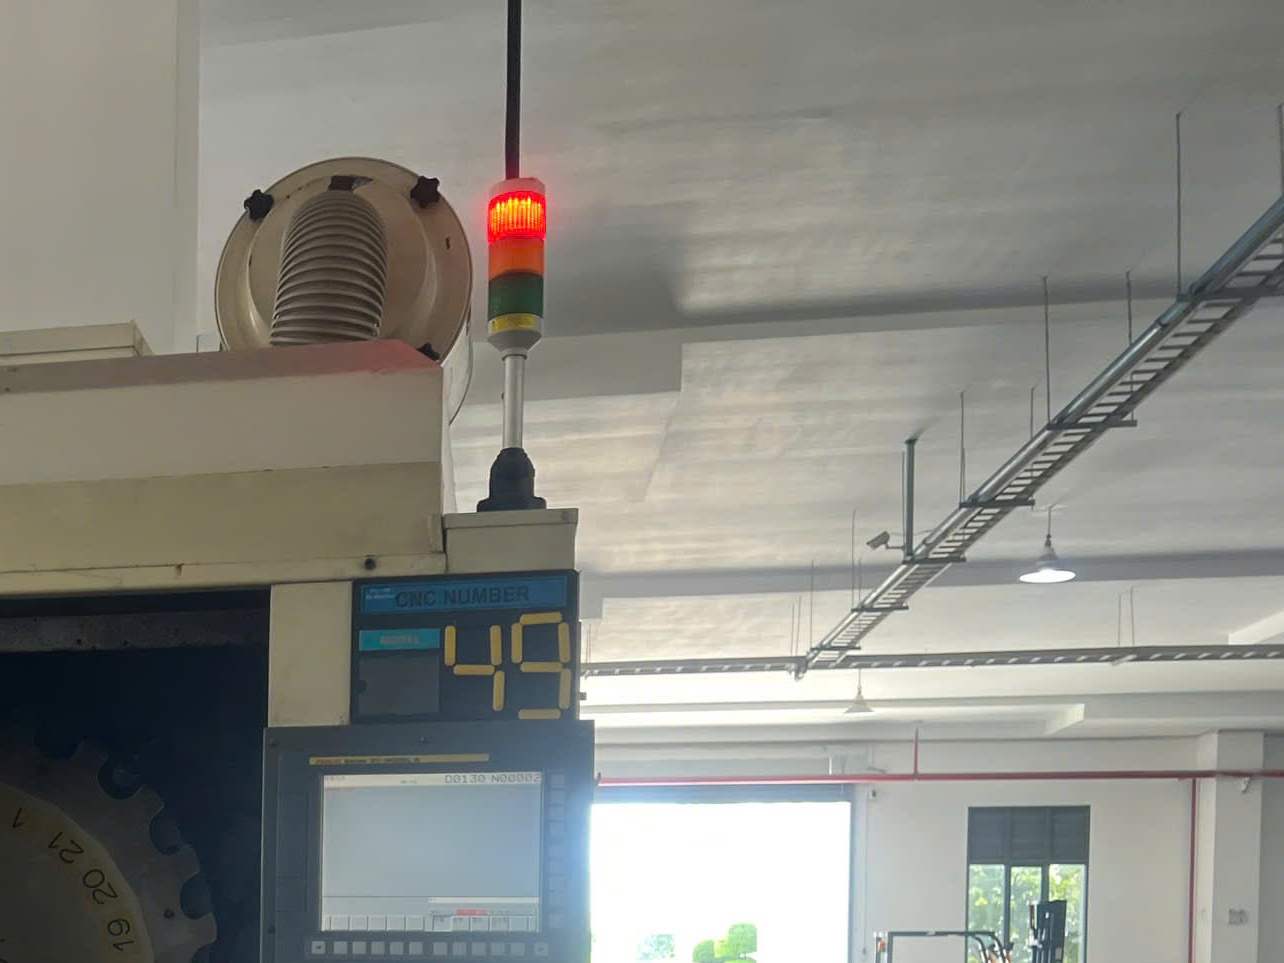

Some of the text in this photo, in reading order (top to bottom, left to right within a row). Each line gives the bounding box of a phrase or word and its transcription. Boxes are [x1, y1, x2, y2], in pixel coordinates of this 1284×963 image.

[395, 590, 437, 608] CNC
[444, 585, 530, 605] NUMBER
[445, 611, 572, 720] 49
[47, 831, 85, 865] 21
[82, 868, 119, 905] 20
[107, 918, 135, 952] 19
